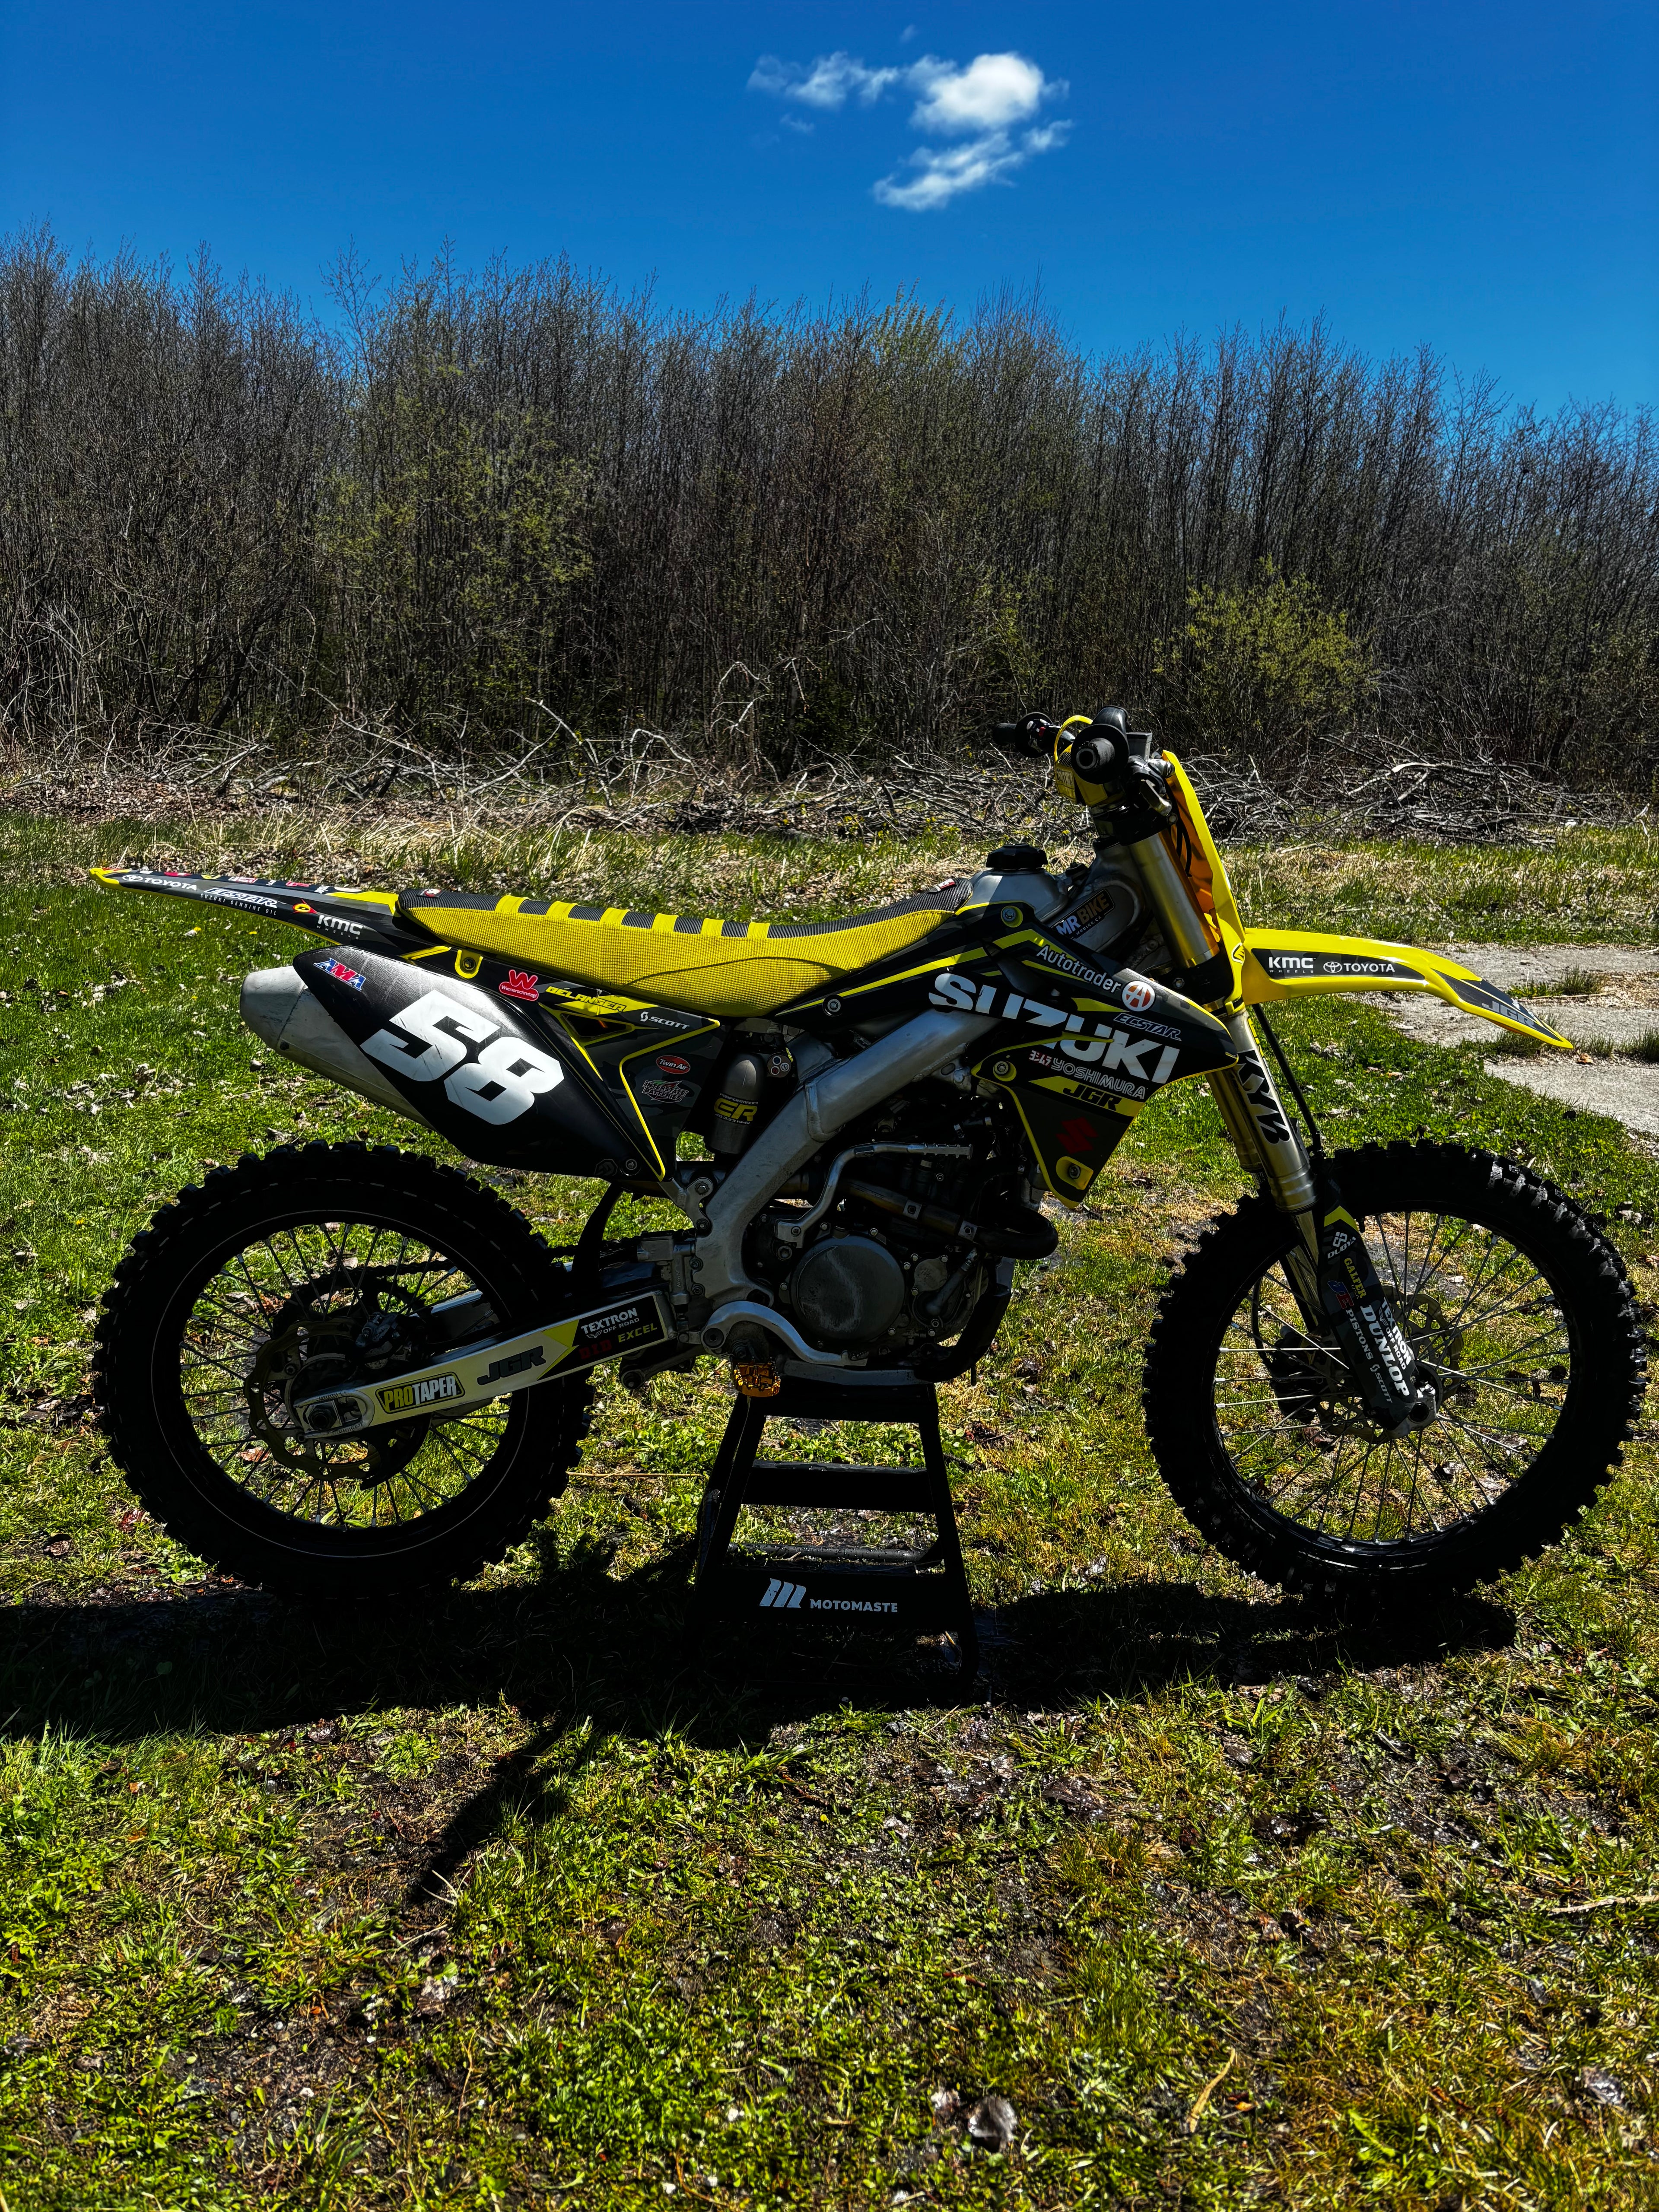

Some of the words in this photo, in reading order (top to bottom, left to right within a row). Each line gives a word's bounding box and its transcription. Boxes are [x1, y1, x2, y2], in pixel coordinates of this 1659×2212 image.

[144, 877, 197, 891] TOYOTA
[200, 893, 225, 903] SUZUKI
[230, 900, 260, 912] GENUINE
[203, 888, 277, 909] ECSTAR
[318, 915, 363, 935] KMC
[1055, 915, 1081, 936] MR
[1076, 893, 1109, 925] BIKE
[313, 957, 367, 992] AMA
[1036, 944, 1122, 993] Autotrader
[1268, 957, 1314, 969] KMC
[1343, 963, 1395, 973] TOYOTA
[648, 1016, 690, 1029] SCOTT
[928, 973, 1180, 1084] SUZUKI
[1113, 1012, 1182, 1041] ECSTAR
[1482, 1001, 1537, 1030] JGR
[360, 989, 565, 1125] 58
[659, 1059, 677, 1068] Twin
[645, 1081, 686, 1096] INTERSTATE
[1051, 1057, 1146, 1099] YOSHIMURA
[644, 1087, 682, 1101] BATTERIES
[1062, 1084, 1122, 1111] JGR
[1327, 1236, 1357, 1259] DUBYA
[1344, 1257, 1367, 1299] GALFER
[581, 1308, 638, 1334] TEXTRON
[603, 1325, 617, 1334] OFF
[619, 1318, 640, 1328] ROAD
[617, 1323, 658, 1343] EXCEL
[1345, 1308, 1374, 1360] PISTONS
[1360, 1304, 1410, 1396] DUNLOP
[1386, 1327, 1395, 1344] OFF
[1393, 1345, 1407, 1370] ROAD
[477, 1345, 547, 1386] JGR
[1375, 1372, 1393, 1404] SCOTT
[810, 1599, 898, 1613] MOTOMASTE
